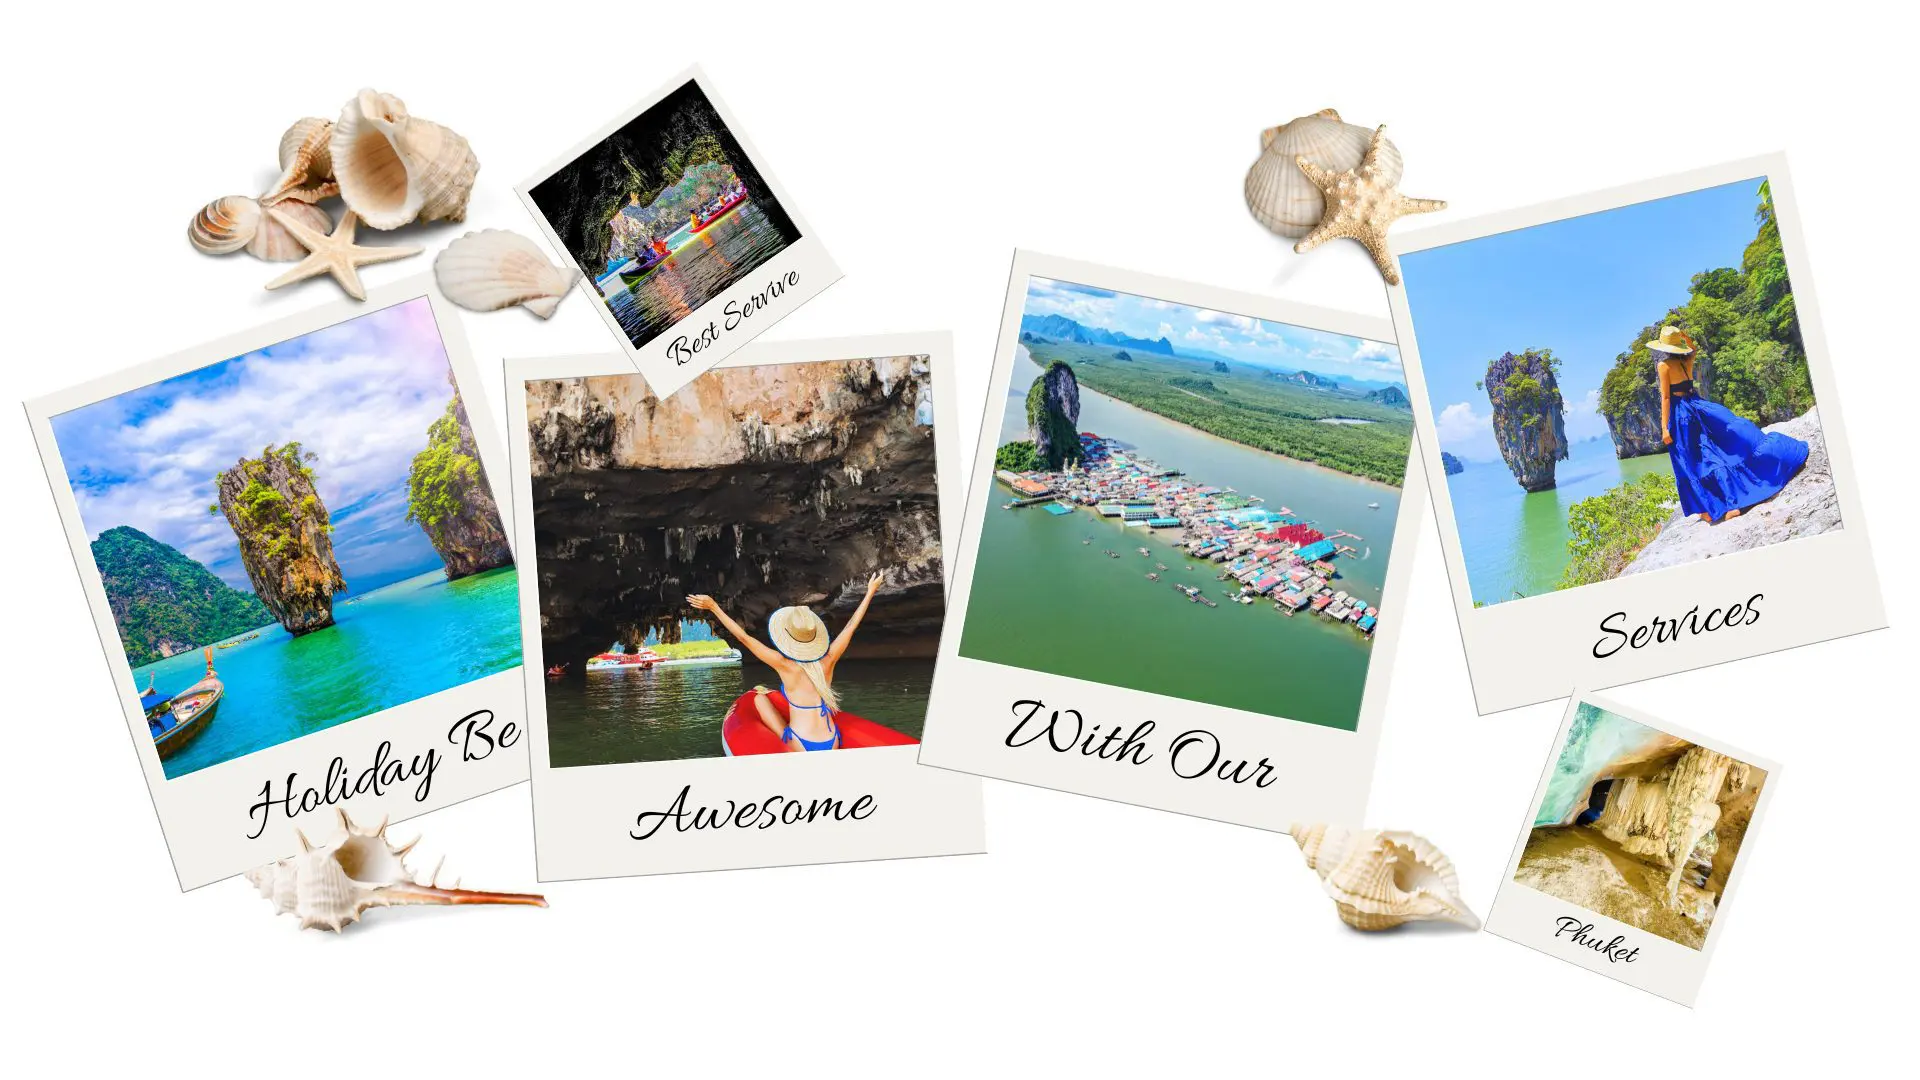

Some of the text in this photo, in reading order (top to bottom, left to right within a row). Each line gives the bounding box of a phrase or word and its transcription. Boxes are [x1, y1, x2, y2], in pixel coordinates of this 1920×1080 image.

[666, 270, 800, 367] Best Servive
[1592, 593, 1764, 659] Services
[246, 709, 522, 840] Holiday Be
[1004, 699, 1278, 789] With Our
[629, 784, 878, 841] Awesome
[1554, 916, 1641, 964] Phuket
